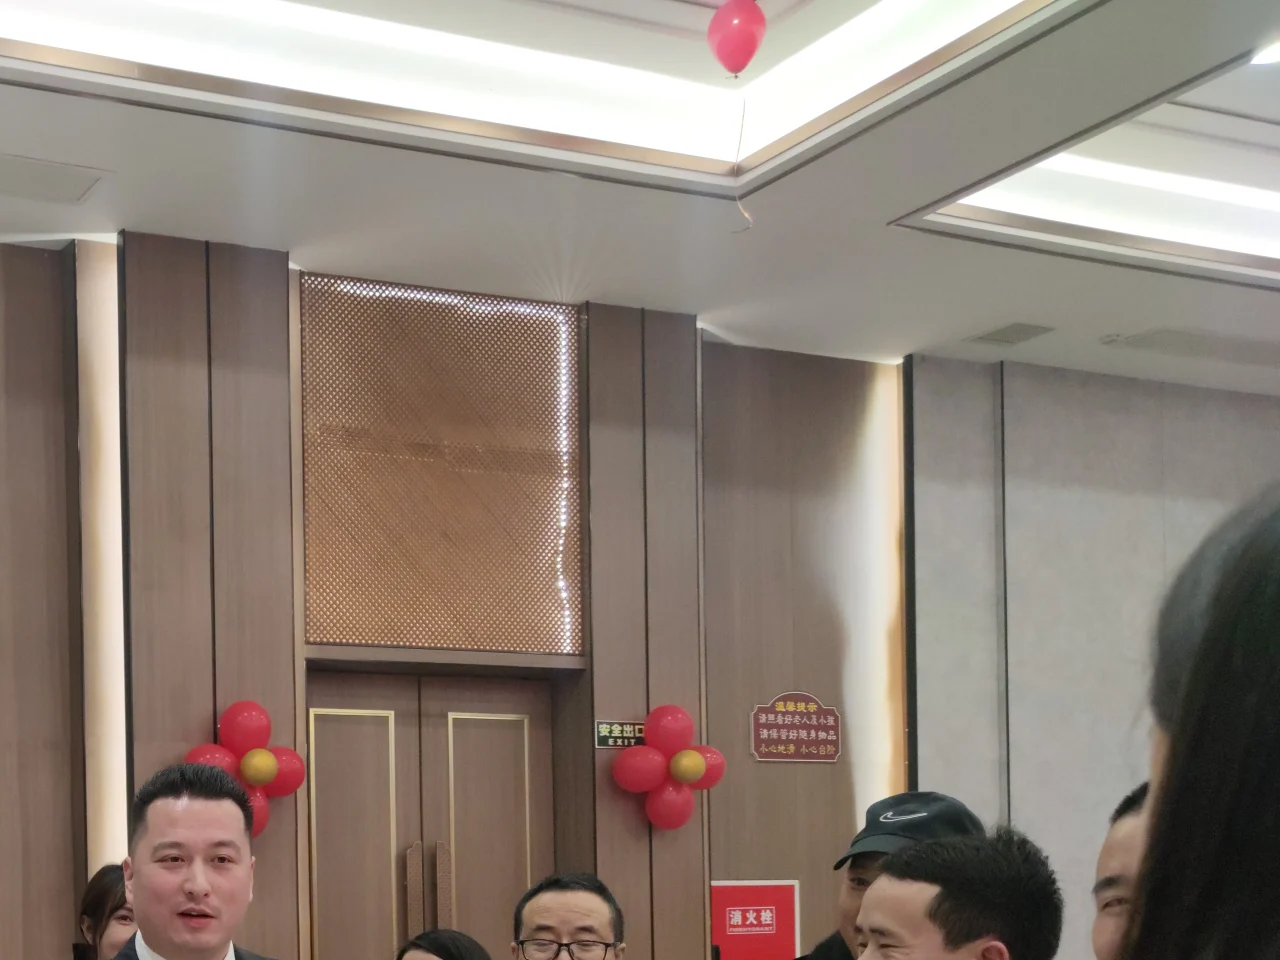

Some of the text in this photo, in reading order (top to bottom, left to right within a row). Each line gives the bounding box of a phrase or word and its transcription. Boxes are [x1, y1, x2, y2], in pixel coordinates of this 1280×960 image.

[775, 701, 817, 712] 温馨提示
[758, 713, 835, 726] 请照看好老人及小孩
[598, 723, 644, 737] 安全出口
[759, 728, 837, 740] 请保管好随身物品
[608, 738, 636, 746] EXIT
[759, 743, 836, 755] 小心地滑 小心台阶
[729, 909, 773, 925] 消火栓
